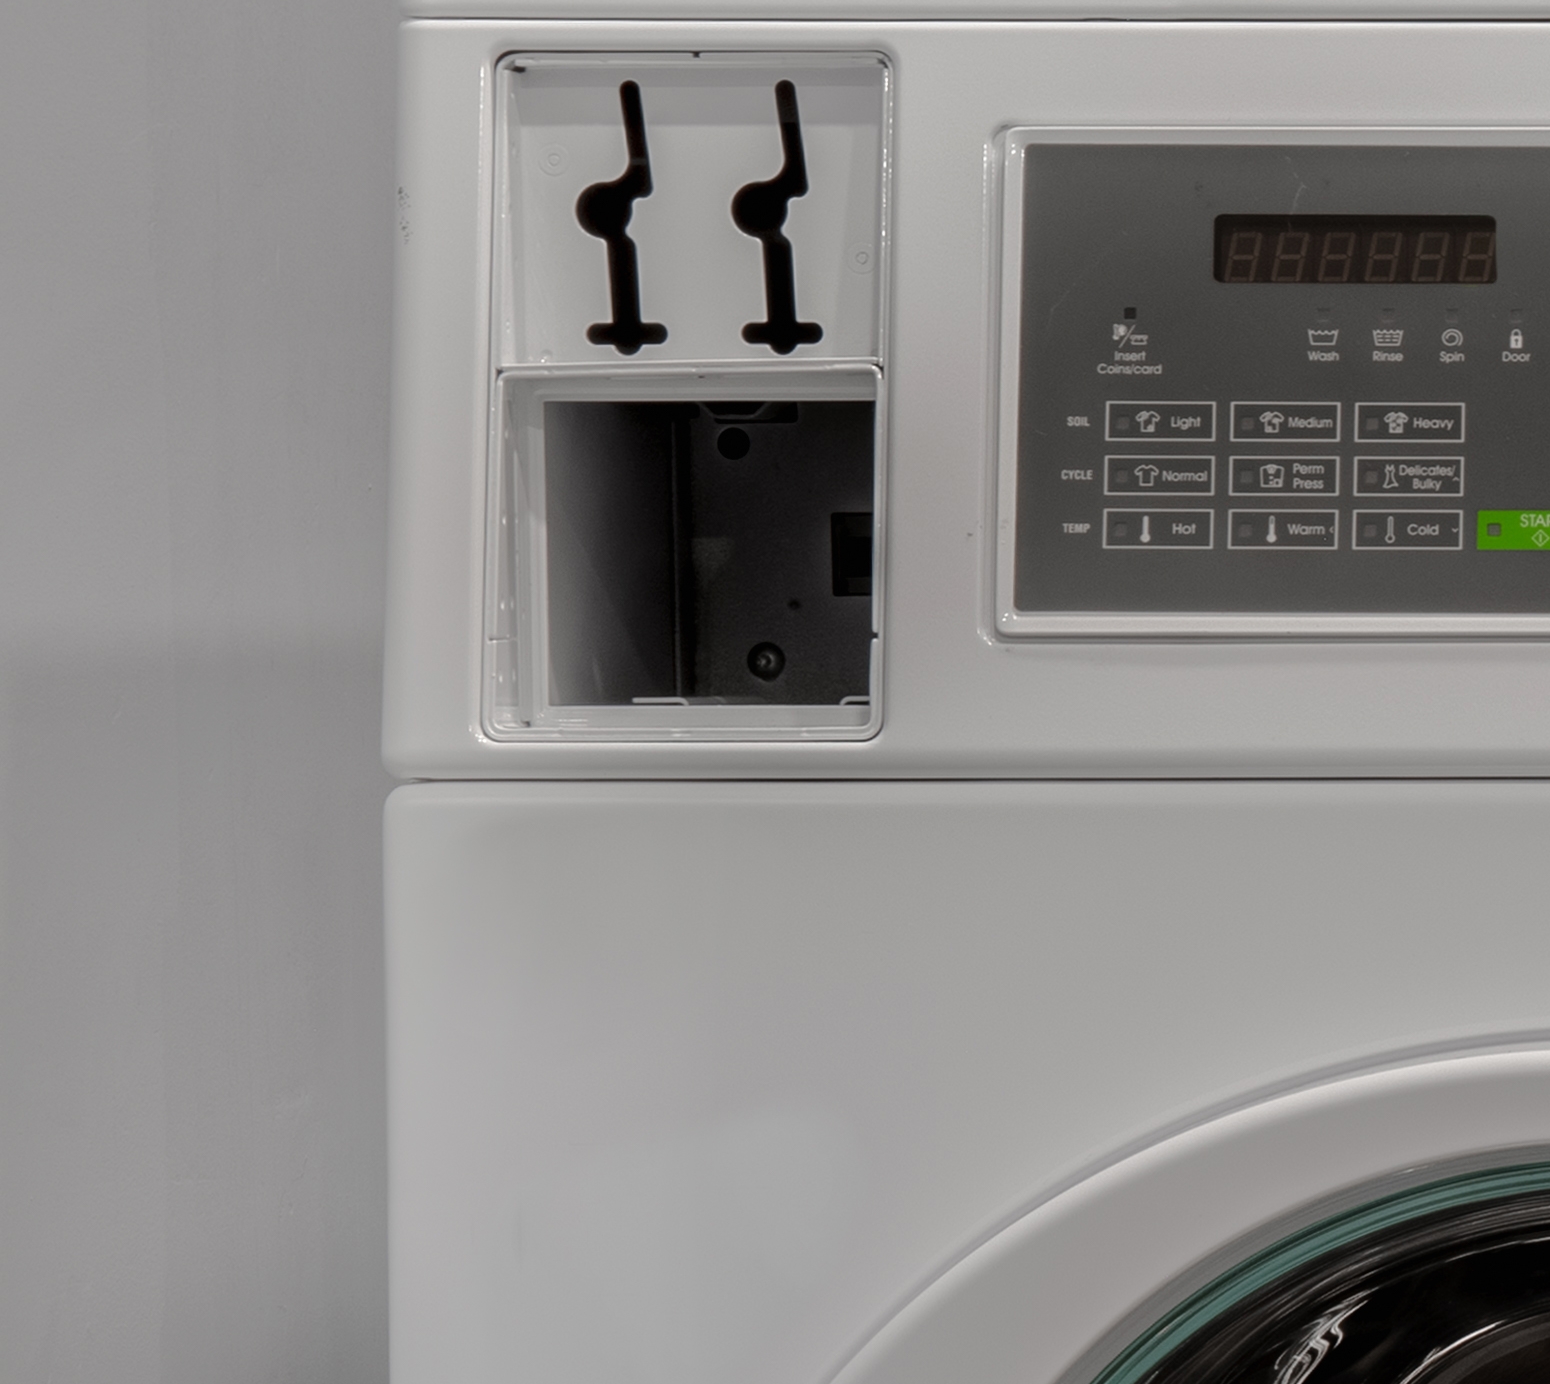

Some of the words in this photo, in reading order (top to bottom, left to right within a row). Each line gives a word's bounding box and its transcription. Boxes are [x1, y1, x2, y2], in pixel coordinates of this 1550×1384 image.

[1114, 350, 1147, 362] Insert
[1307, 351, 1340, 362] Wash
[1372, 351, 1404, 362] Rinse
[1439, 351, 1465, 364] Spin
[1501, 351, 1531, 362] Door
[1096, 363, 1163, 375] Coins/card
[1066, 416, 1091, 427] SOIL
[1170, 416, 1202, 430] Light
[1287, 416, 1333, 428] Medium
[1413, 417, 1454, 431] Heavy
[1061, 469, 1093, 480] CYCLE
[1292, 463, 1325, 475] Perm
[1162, 470, 1208, 482] Normal
[1292, 478, 1324, 490] Press
[1412, 478, 1443, 492] Bulky
[1061, 522, 1091, 534] TEMP
[1172, 523, 1196, 535] Hot
[1287, 523, 1325, 535] Warm
[1407, 524, 1440, 536] Cold
